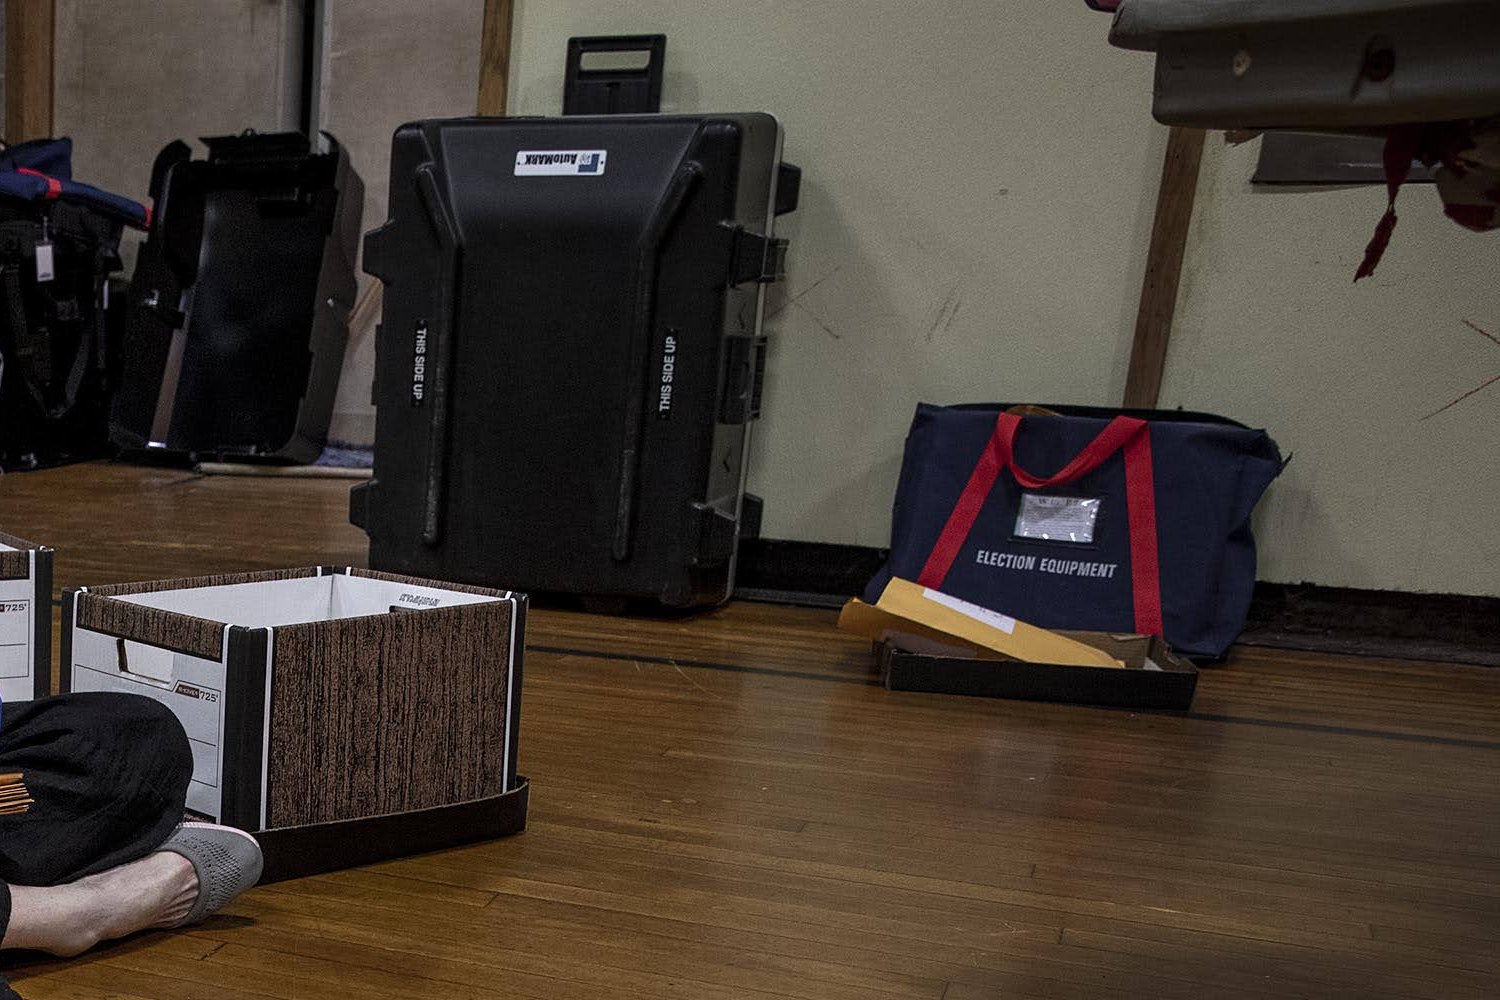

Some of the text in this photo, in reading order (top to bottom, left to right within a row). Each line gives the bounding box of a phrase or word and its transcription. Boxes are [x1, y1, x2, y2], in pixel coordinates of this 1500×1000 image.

[525, 153, 578, 165] AutoMARK
[412, 328, 427, 400] THIS SIDE UP
[659, 336, 676, 412] THIS SIDE UP
[976, 550, 1117, 579] ELECTION EQUIPMENT
